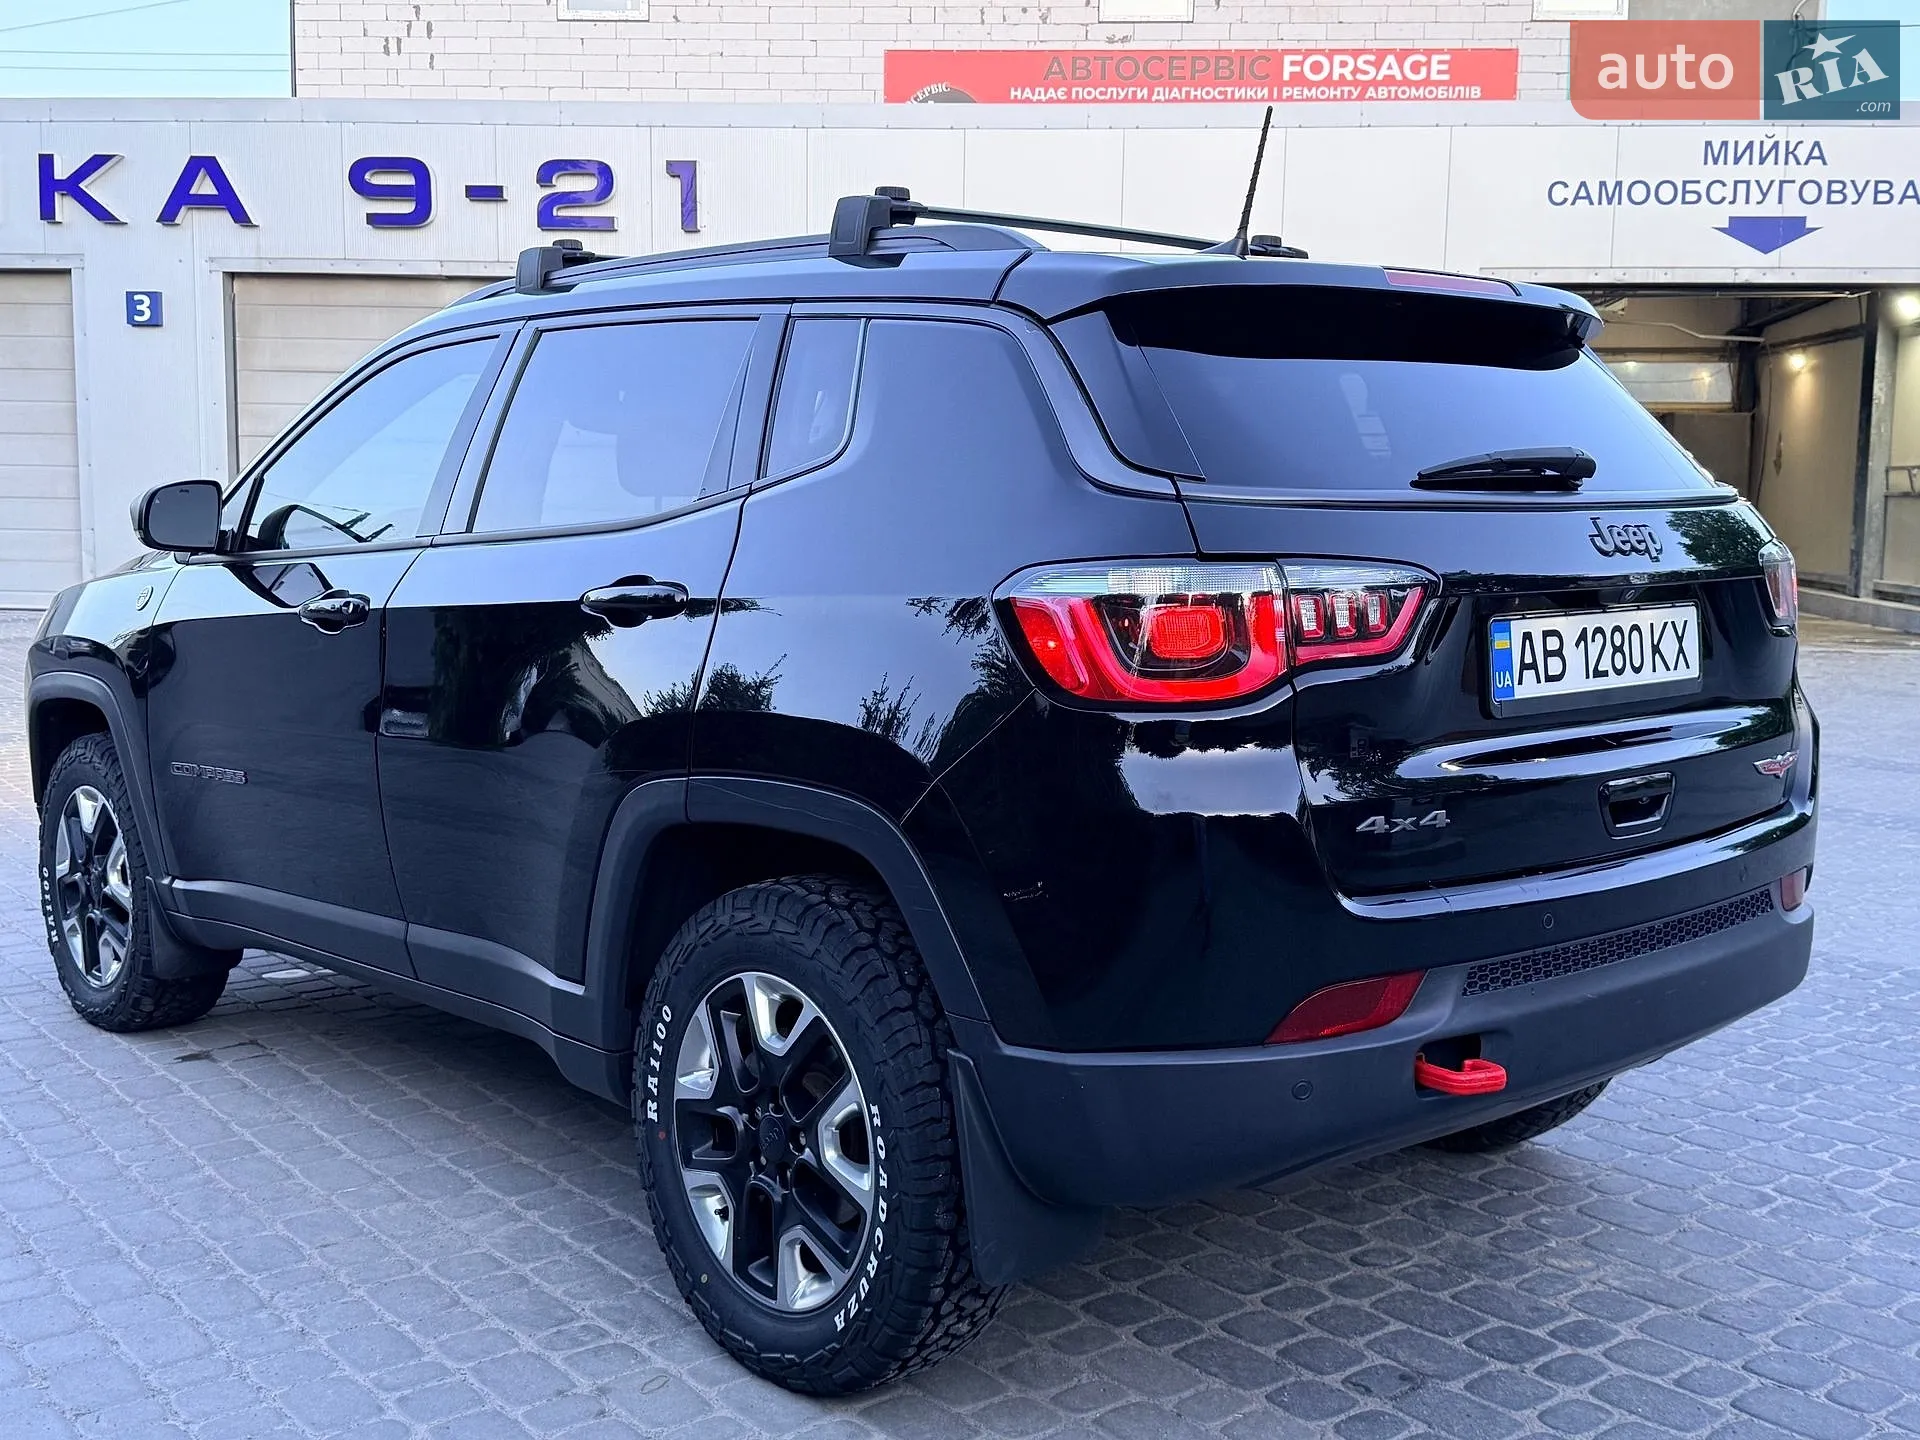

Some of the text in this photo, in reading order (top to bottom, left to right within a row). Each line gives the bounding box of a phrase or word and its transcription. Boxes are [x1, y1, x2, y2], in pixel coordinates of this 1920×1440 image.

[1043, 53, 1452, 82] АВТОСЕРВІС FORSAGE
[1009, 86, 1068, 101] НАДАЄ
[1071, 86, 1149, 101] ПОСЛУГИ
[1151, 86, 1269, 102] ДІАГНОСТИКИ
[1282, 86, 1361, 100] РЕМОНТУ
[1365, 85, 1482, 100] АВТОМОБІЛІВ
[1702, 133, 1829, 166] МИЙКА
[133, 294, 152, 323] 3
[1589, 516, 1664, 561] Jeep
[1517, 619, 1691, 686] AB 1280 KX
[1495, 671, 1512, 689] UA
[646, 1003, 673, 1123] RA1100
[832, 1103, 888, 1334] ROADCRUZA
